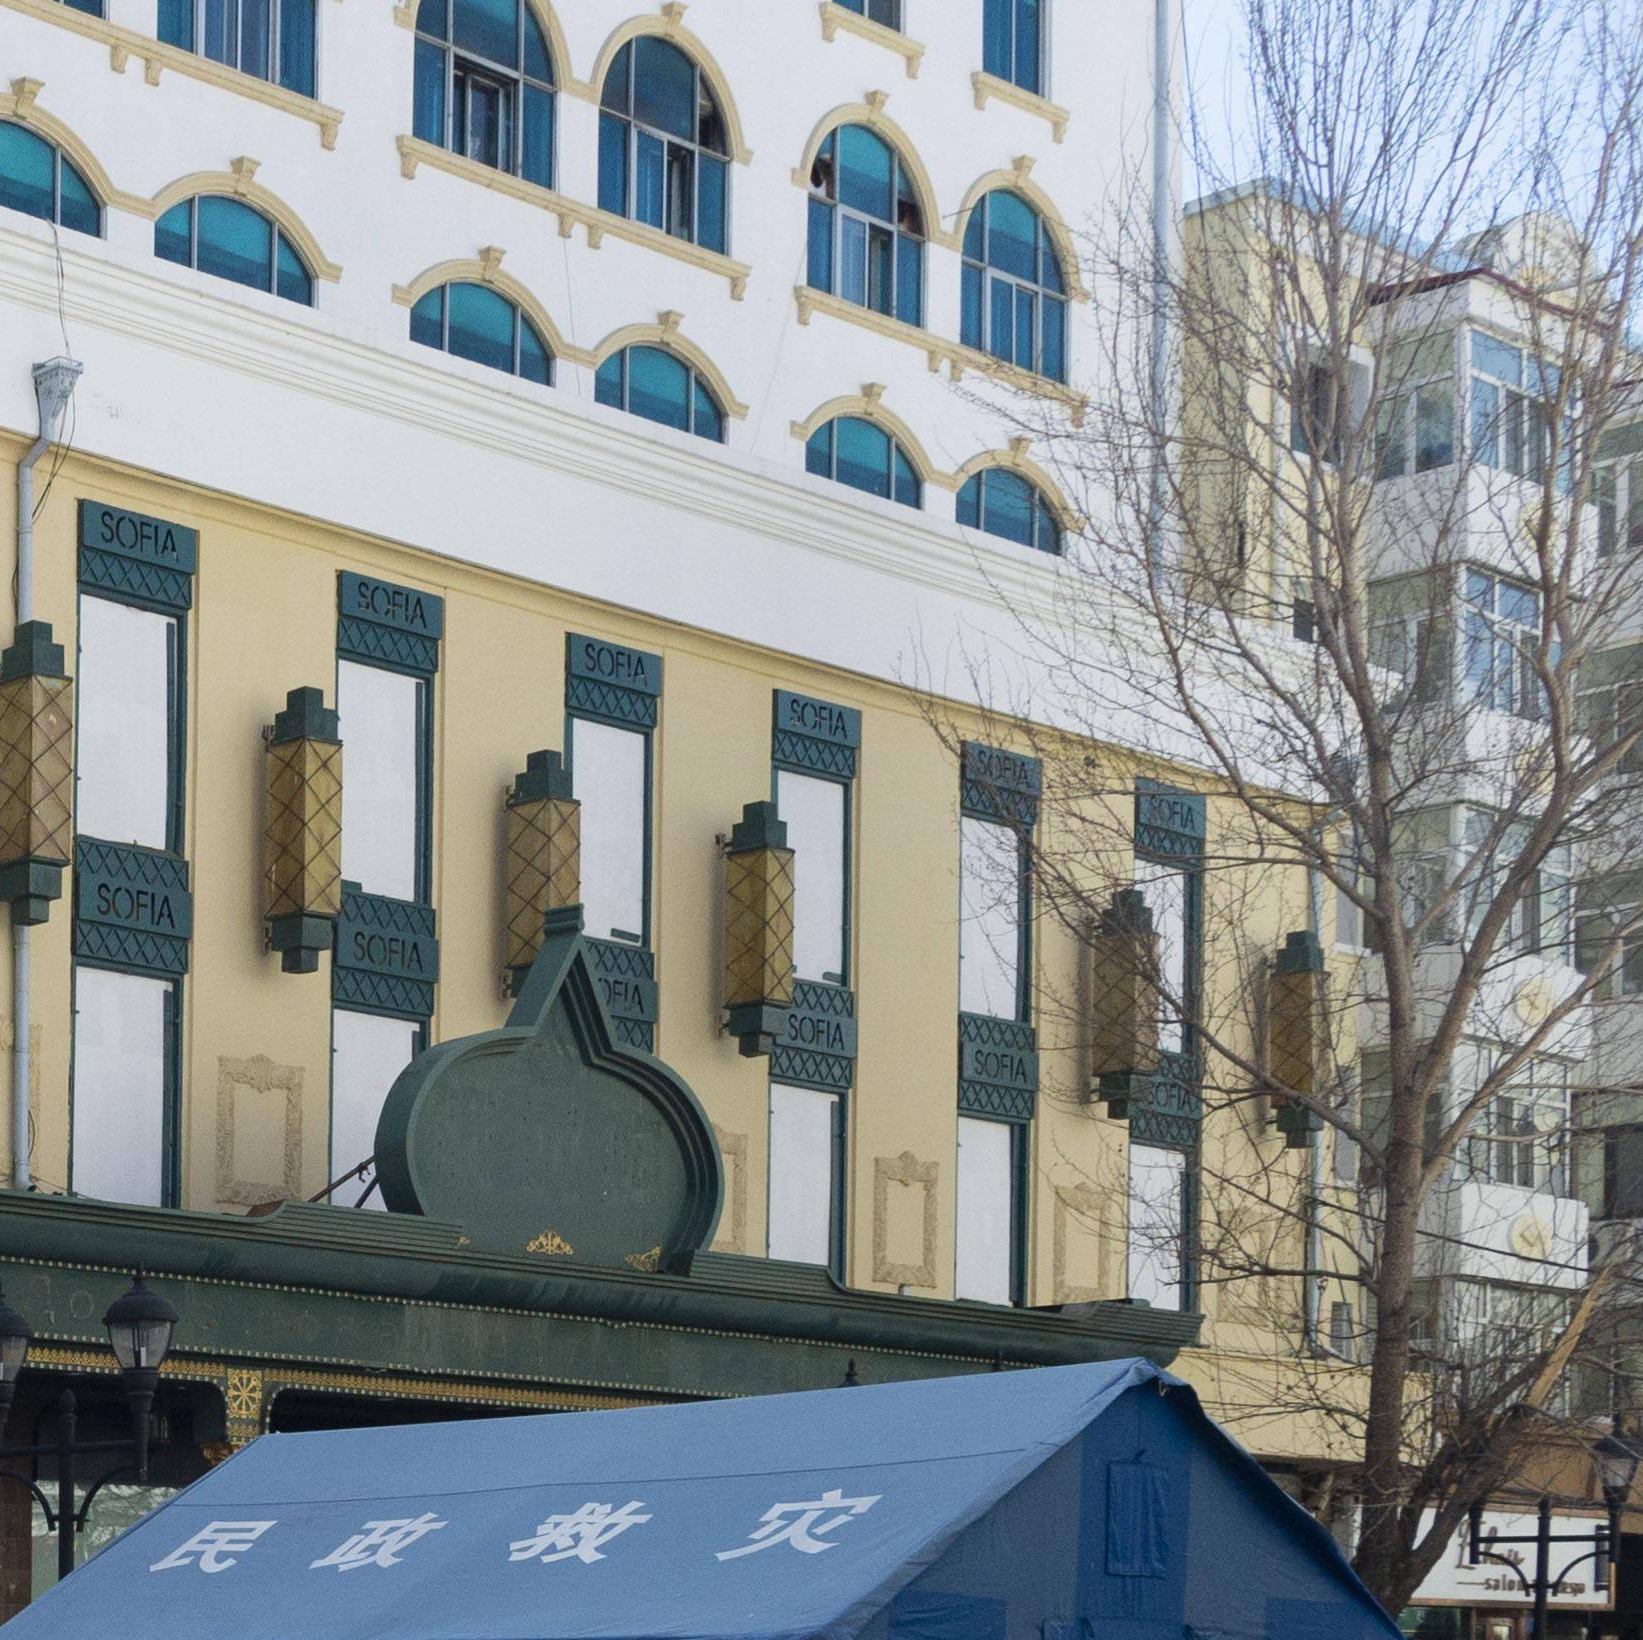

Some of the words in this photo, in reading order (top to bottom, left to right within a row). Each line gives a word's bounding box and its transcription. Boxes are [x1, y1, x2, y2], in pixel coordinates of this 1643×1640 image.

[99, 510, 179, 562] SOFIA
[356, 580, 428, 630] SOFIA
[584, 642, 646, 687] SOFIA
[789, 699, 849, 740] SOFIA
[96, 884, 175, 930] SOFIA
[353, 930, 425, 973] SOFIA
[787, 1017, 847, 1050] SOFIA
[973, 1048, 1027, 1080] SOFIA
[149, 1489, 883, 1574] 民政救灾
